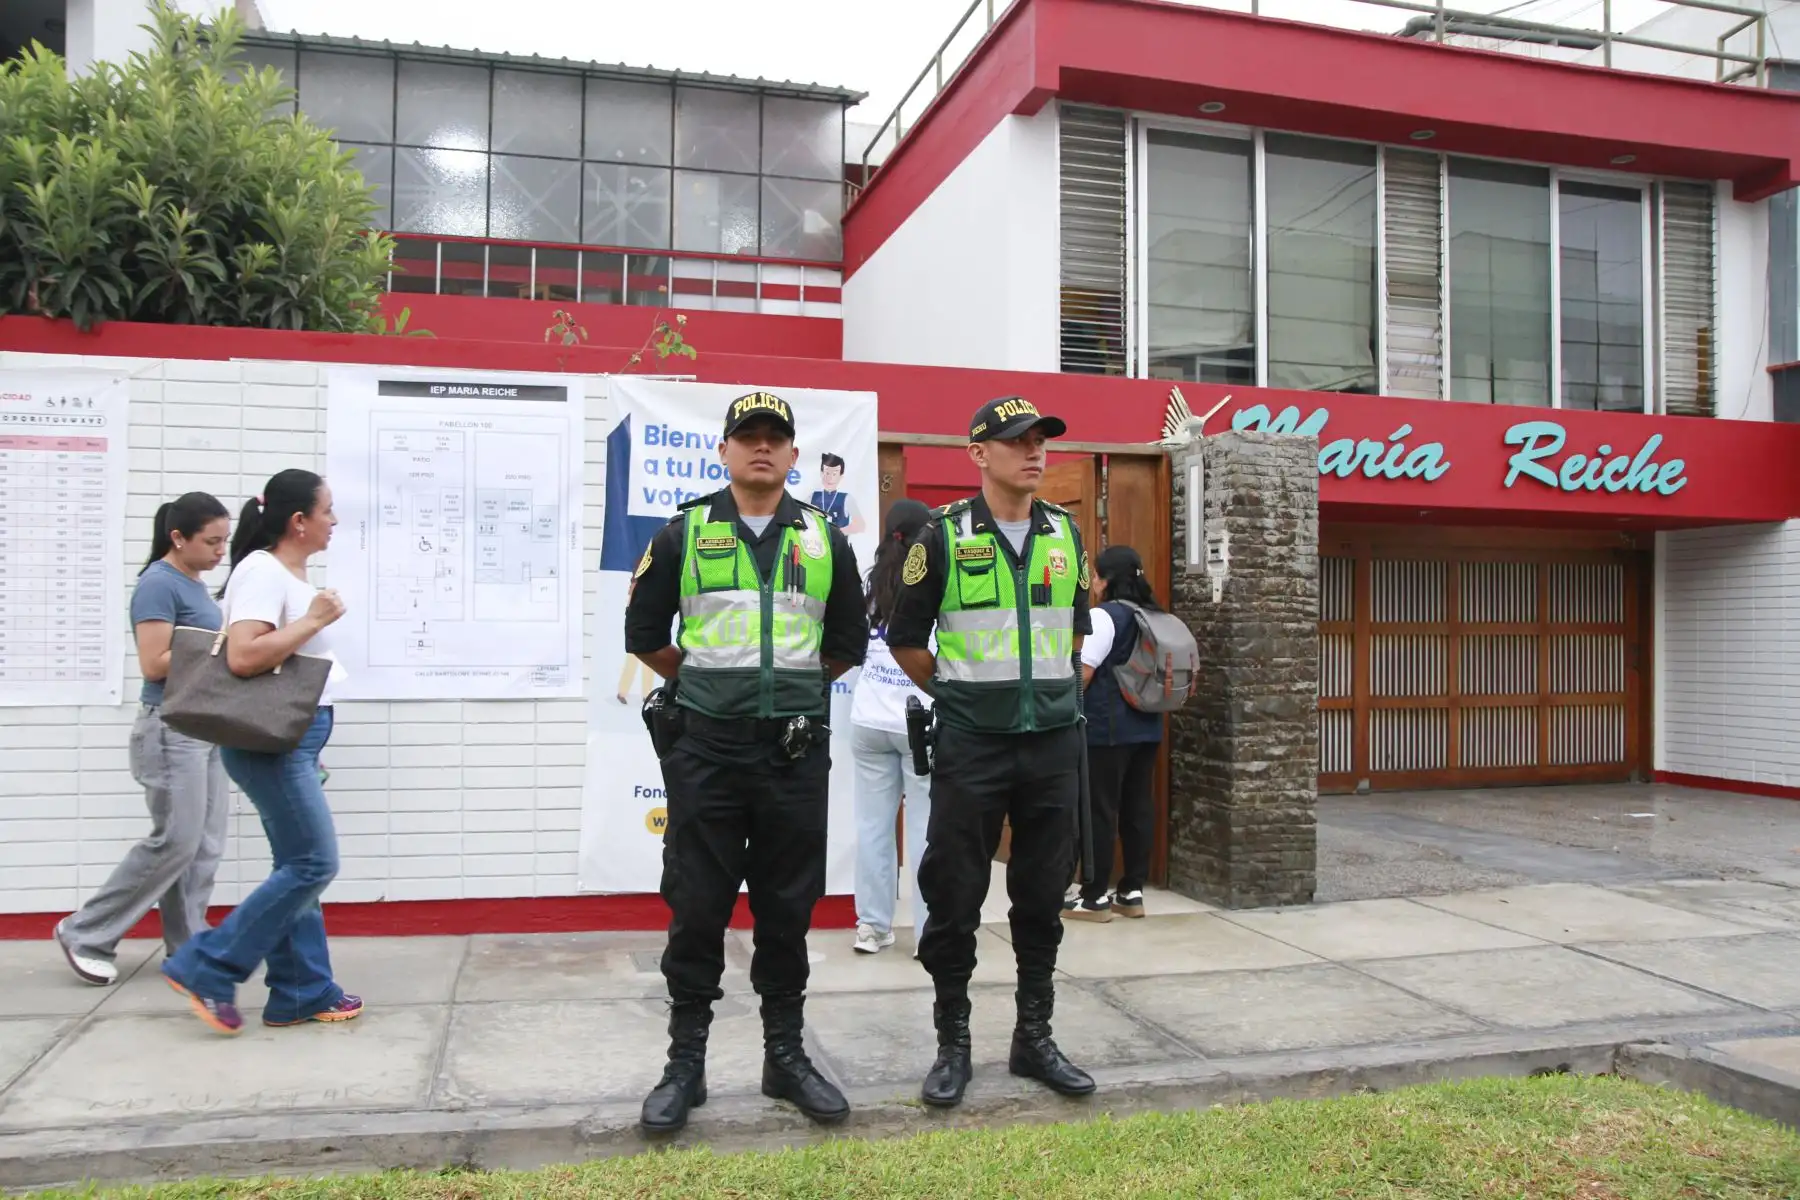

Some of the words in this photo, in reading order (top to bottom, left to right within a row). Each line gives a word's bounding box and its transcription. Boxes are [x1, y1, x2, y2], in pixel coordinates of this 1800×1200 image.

[430, 385, 446, 394] IEP
[448, 386, 480, 395] MARIA
[481, 388, 518, 396] REICHE
[733, 392, 789, 422] POLICIA
[644, 423, 724, 450] Bienv
[644, 459, 658, 476] a
[666, 457, 692, 478] tu
[1504, 421, 1688, 495] Reiche
